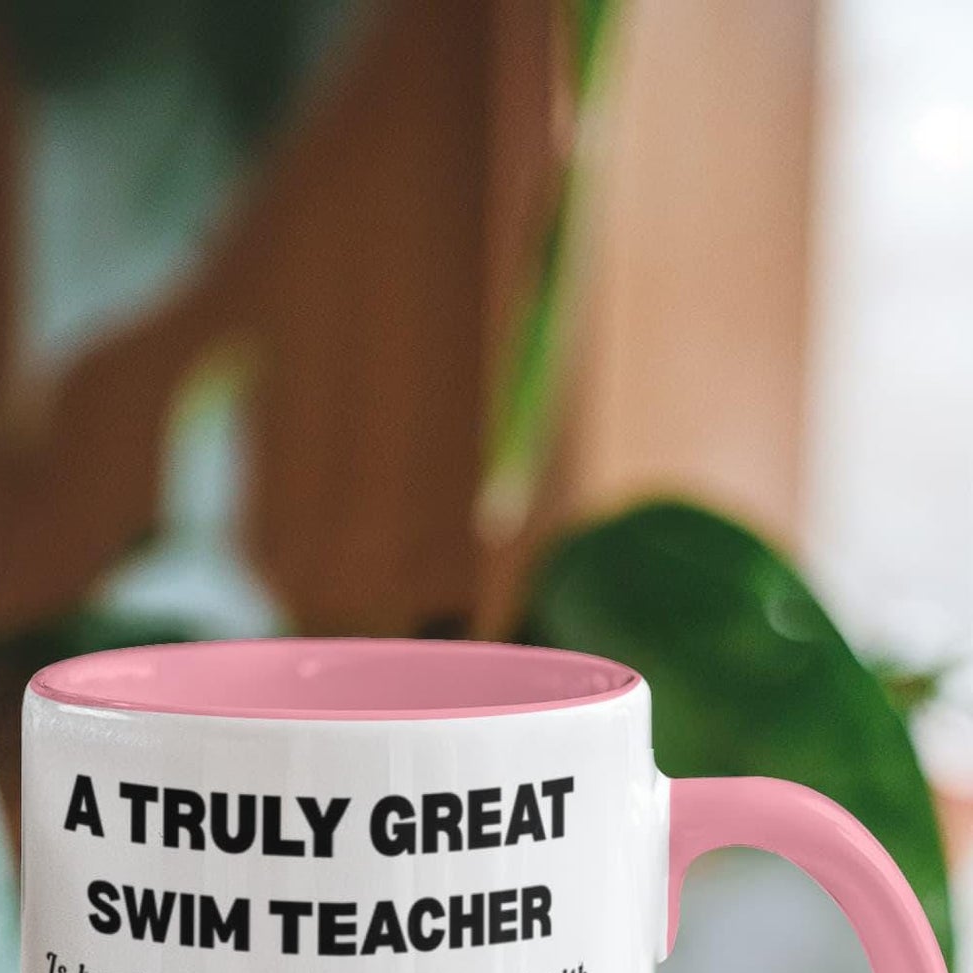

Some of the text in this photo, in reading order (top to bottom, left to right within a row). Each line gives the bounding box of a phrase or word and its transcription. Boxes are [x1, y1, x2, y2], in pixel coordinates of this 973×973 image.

[63, 773, 574, 859] A TRULY GREAT
[86, 879, 552, 957] SWIM TEACHER
